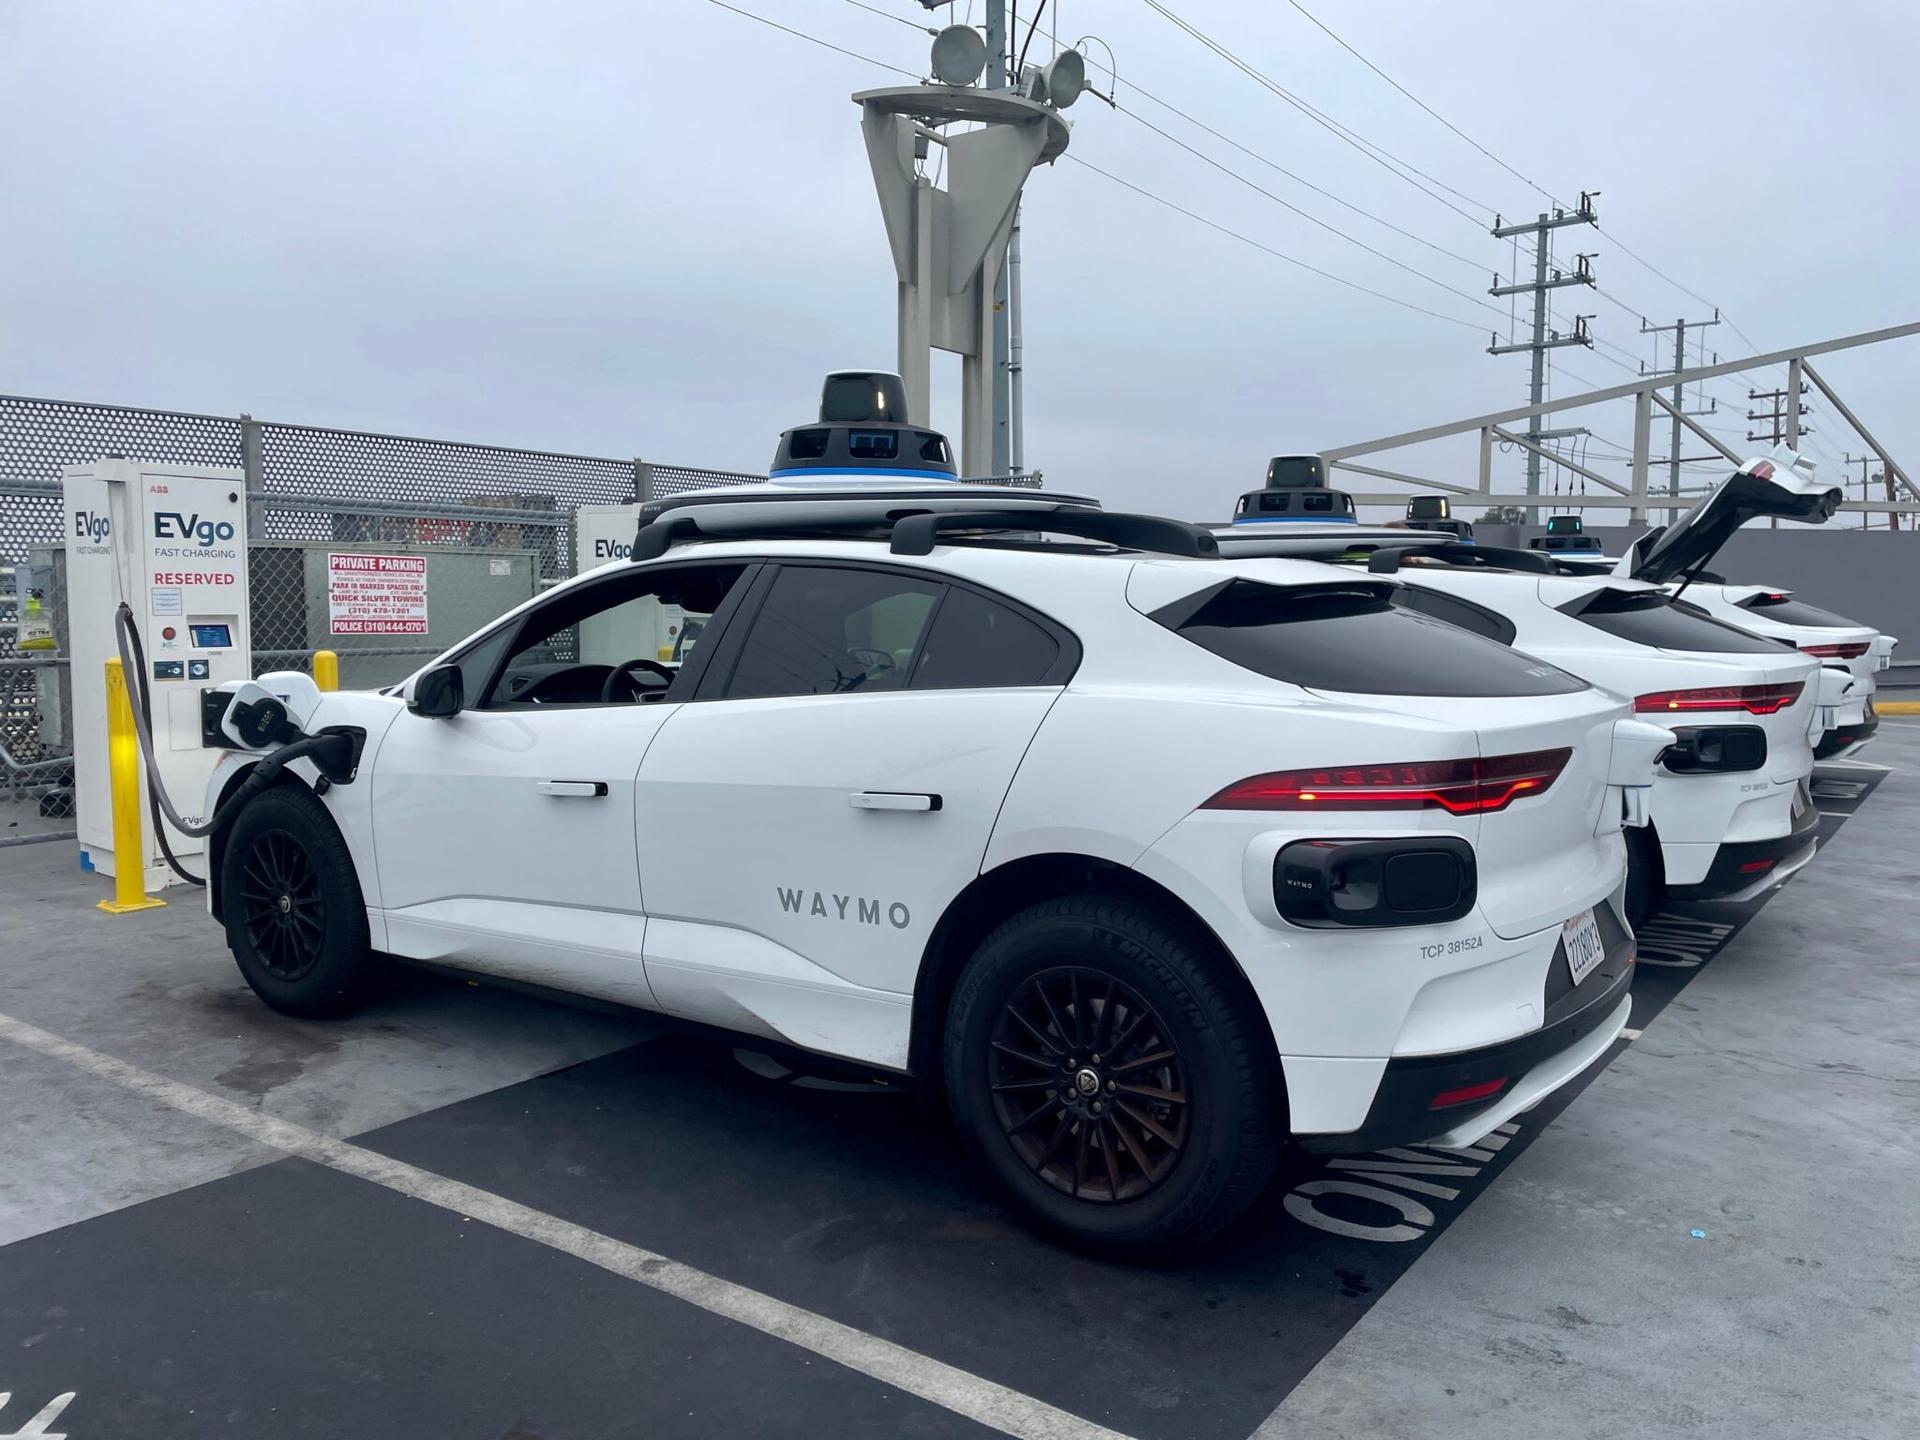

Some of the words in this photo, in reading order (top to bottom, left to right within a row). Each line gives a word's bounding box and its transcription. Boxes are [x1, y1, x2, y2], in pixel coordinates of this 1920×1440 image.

[150, 485, 168, 494] ABB
[75, 511, 110, 544] EVgo
[154, 512, 234, 547] EVgo
[155, 548, 180, 557] FAST
[182, 548, 235, 558] CHARGING
[595, 539, 632, 560] EVgo
[331, 556, 377, 570] PRIVATE
[379, 558, 424, 572] PARKING
[154, 573, 235, 585] RESERVED
[331, 594, 359, 602] QUICK
[392, 595, 424, 603] TOWING
[333, 621, 362, 632] POLICE
[1287, 879, 1313, 889] WAYMO
[776, 887, 911, 929] WAYMO
[1420, 944, 1445, 959] TCP
[1447, 936, 1483, 954] 38152A
